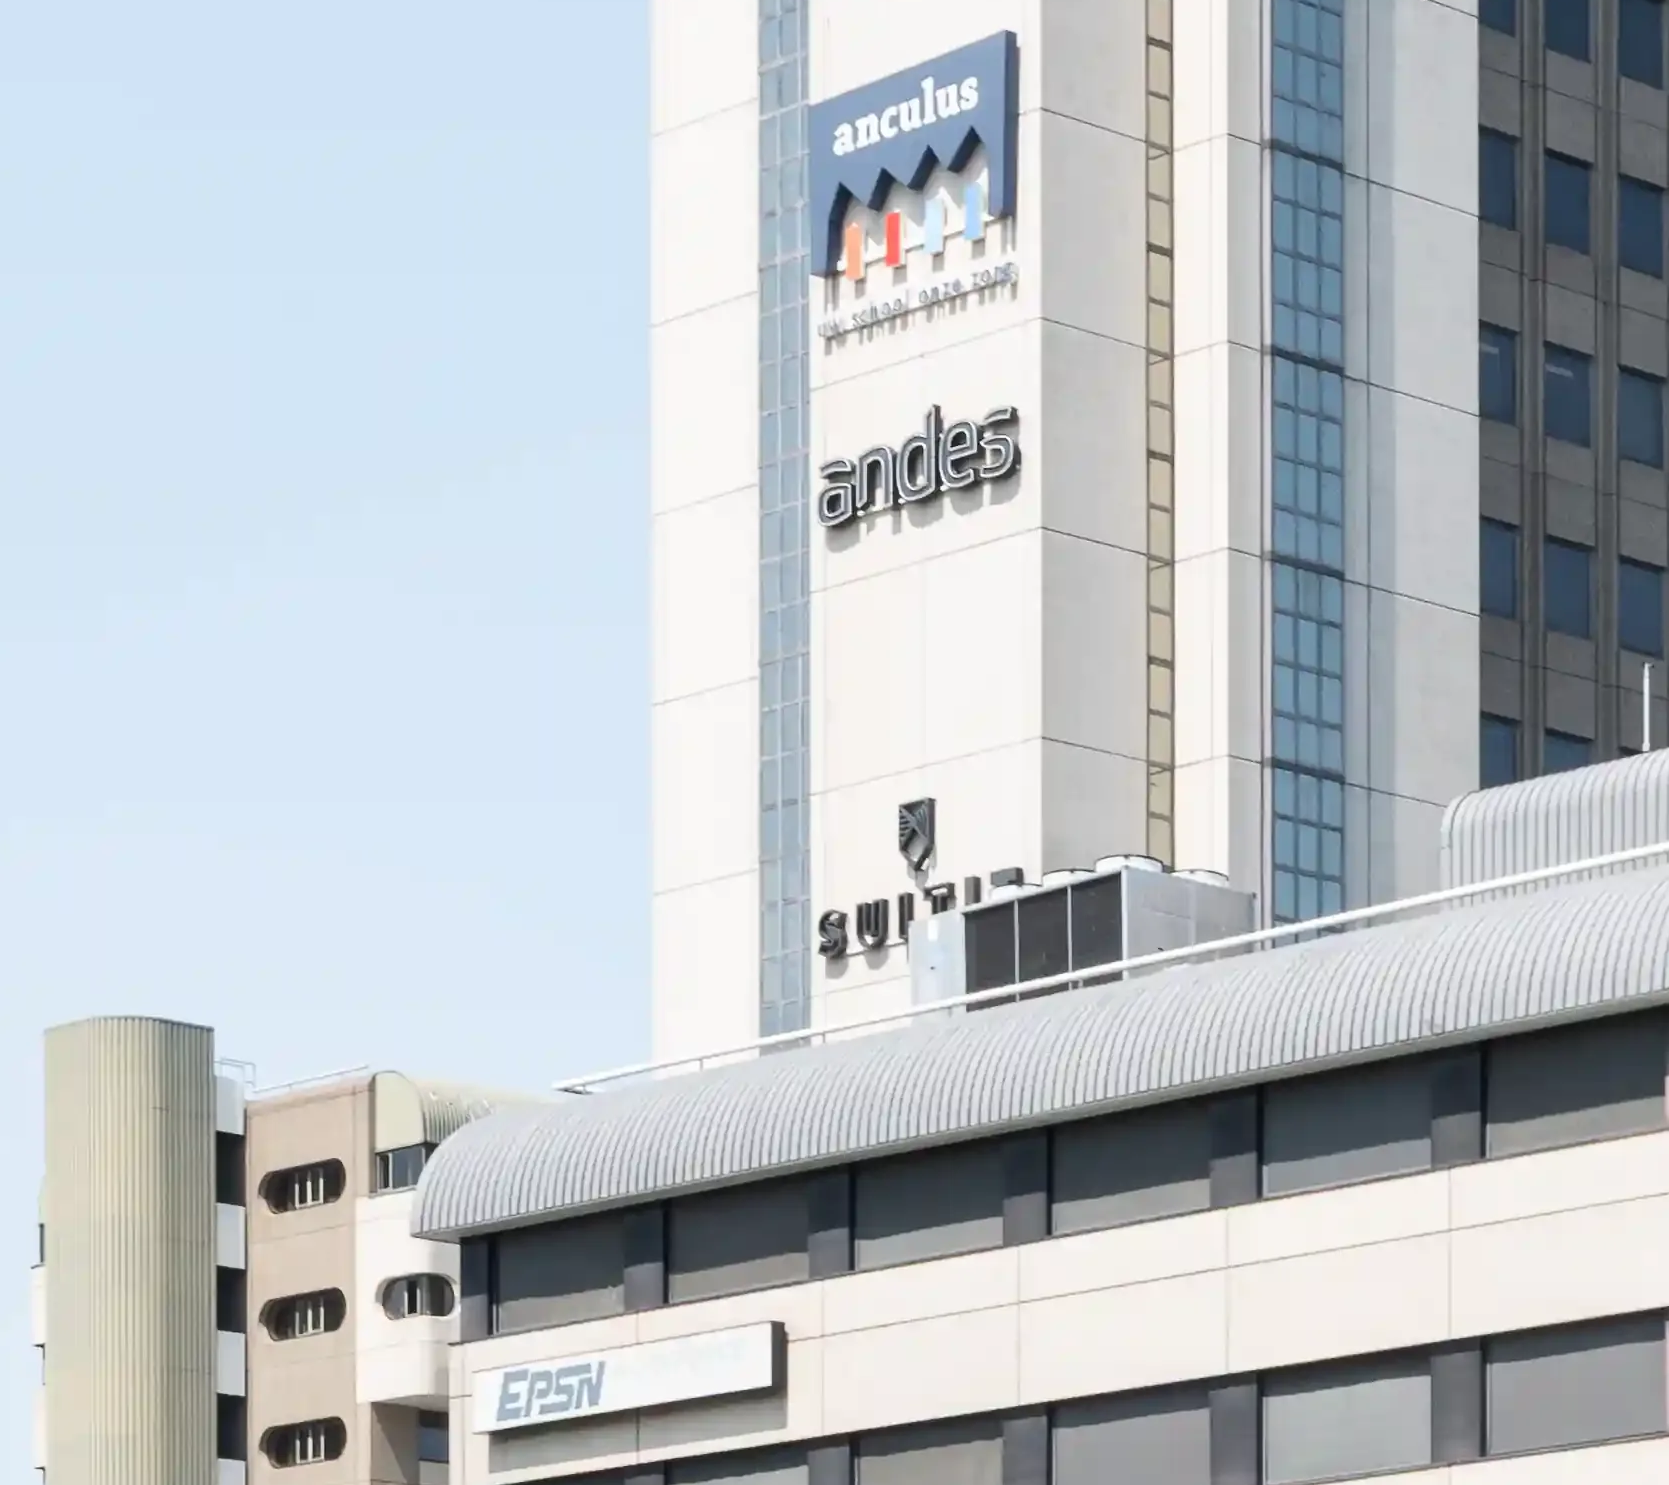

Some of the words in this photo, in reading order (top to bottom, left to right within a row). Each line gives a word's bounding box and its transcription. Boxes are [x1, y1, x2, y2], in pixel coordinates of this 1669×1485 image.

[832, 74, 979, 157] anculus
[851, 288, 911, 328] school
[817, 403, 1021, 530] andes
[496, 1360, 606, 1423] EPSN
